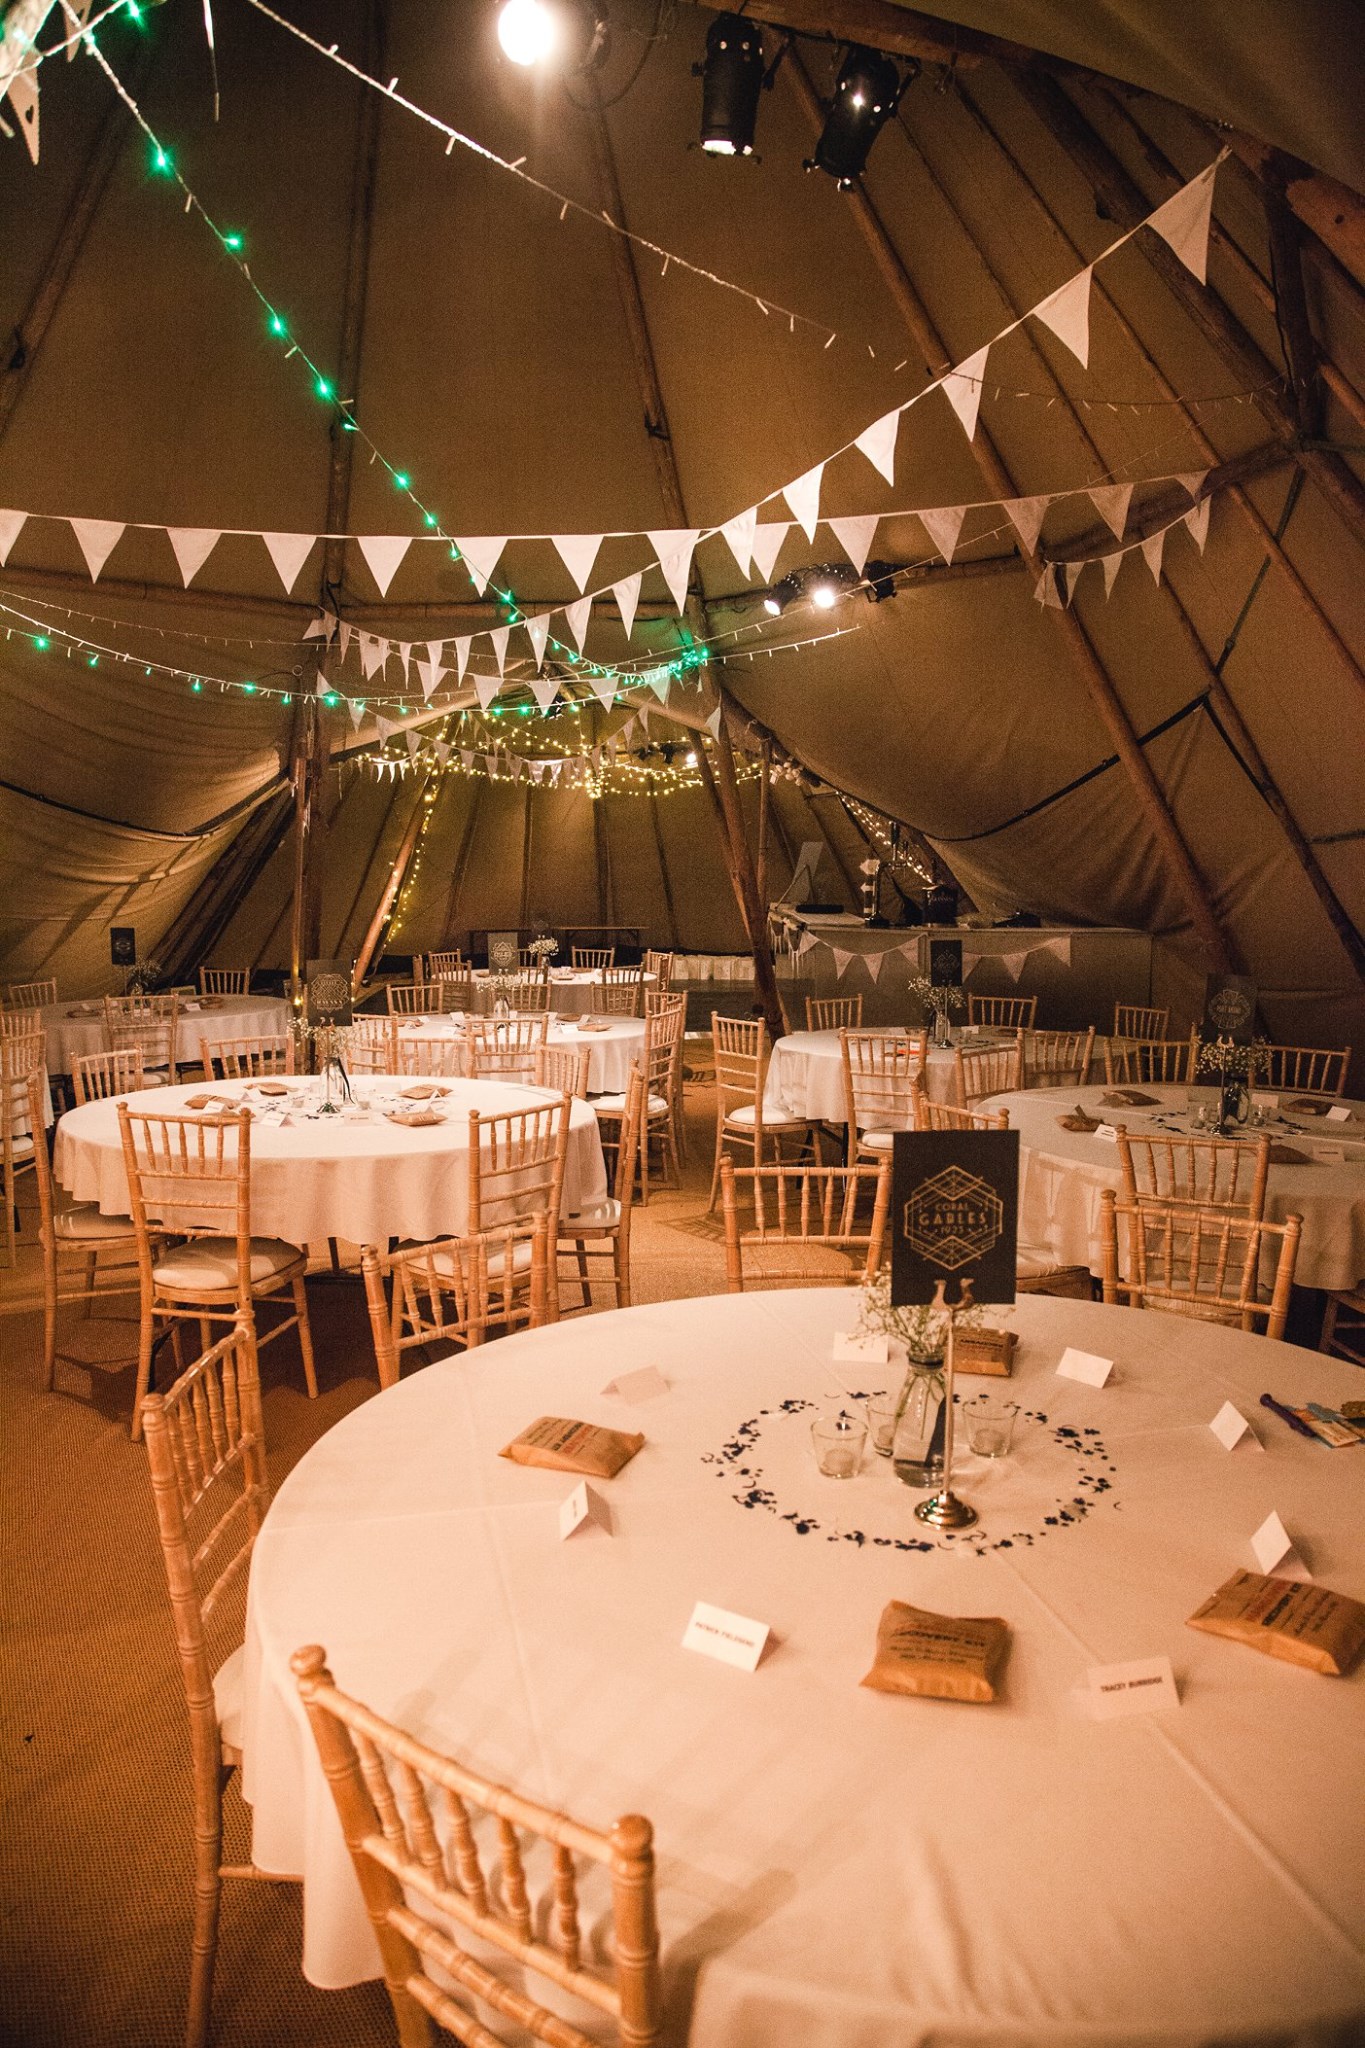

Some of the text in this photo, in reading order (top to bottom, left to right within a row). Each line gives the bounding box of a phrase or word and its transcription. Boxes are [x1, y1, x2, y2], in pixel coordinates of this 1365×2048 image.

[935, 1202, 969, 1211] CORAL
[919, 1212, 986, 1226] GABLES
[1100, 1682, 1126, 1693] TRACEY
